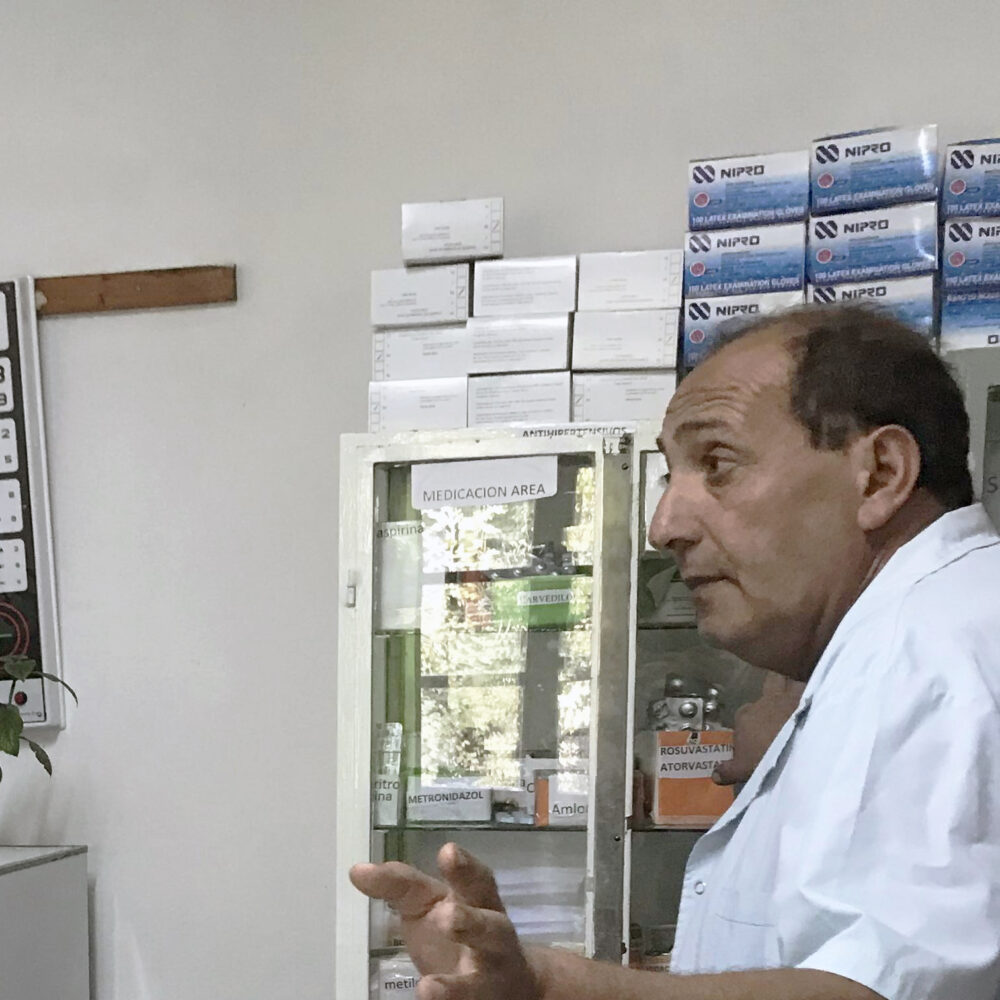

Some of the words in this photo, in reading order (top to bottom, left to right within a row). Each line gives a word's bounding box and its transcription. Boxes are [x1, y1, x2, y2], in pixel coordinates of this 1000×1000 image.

[844, 142, 891, 158] NIPRO
[720, 165, 765, 179] NIPRO
[843, 219, 889, 234] NIPRO
[716, 235, 760, 248] NIPRO
[841, 286, 887, 300] NIPRO
[716, 303, 760, 316] NIPRO
[423, 486, 507, 502] MEDICACION
[511, 483, 546, 497] AREA
[376, 525, 424, 539] aspirina
[408, 791, 484, 805] METRONIDAZOL
